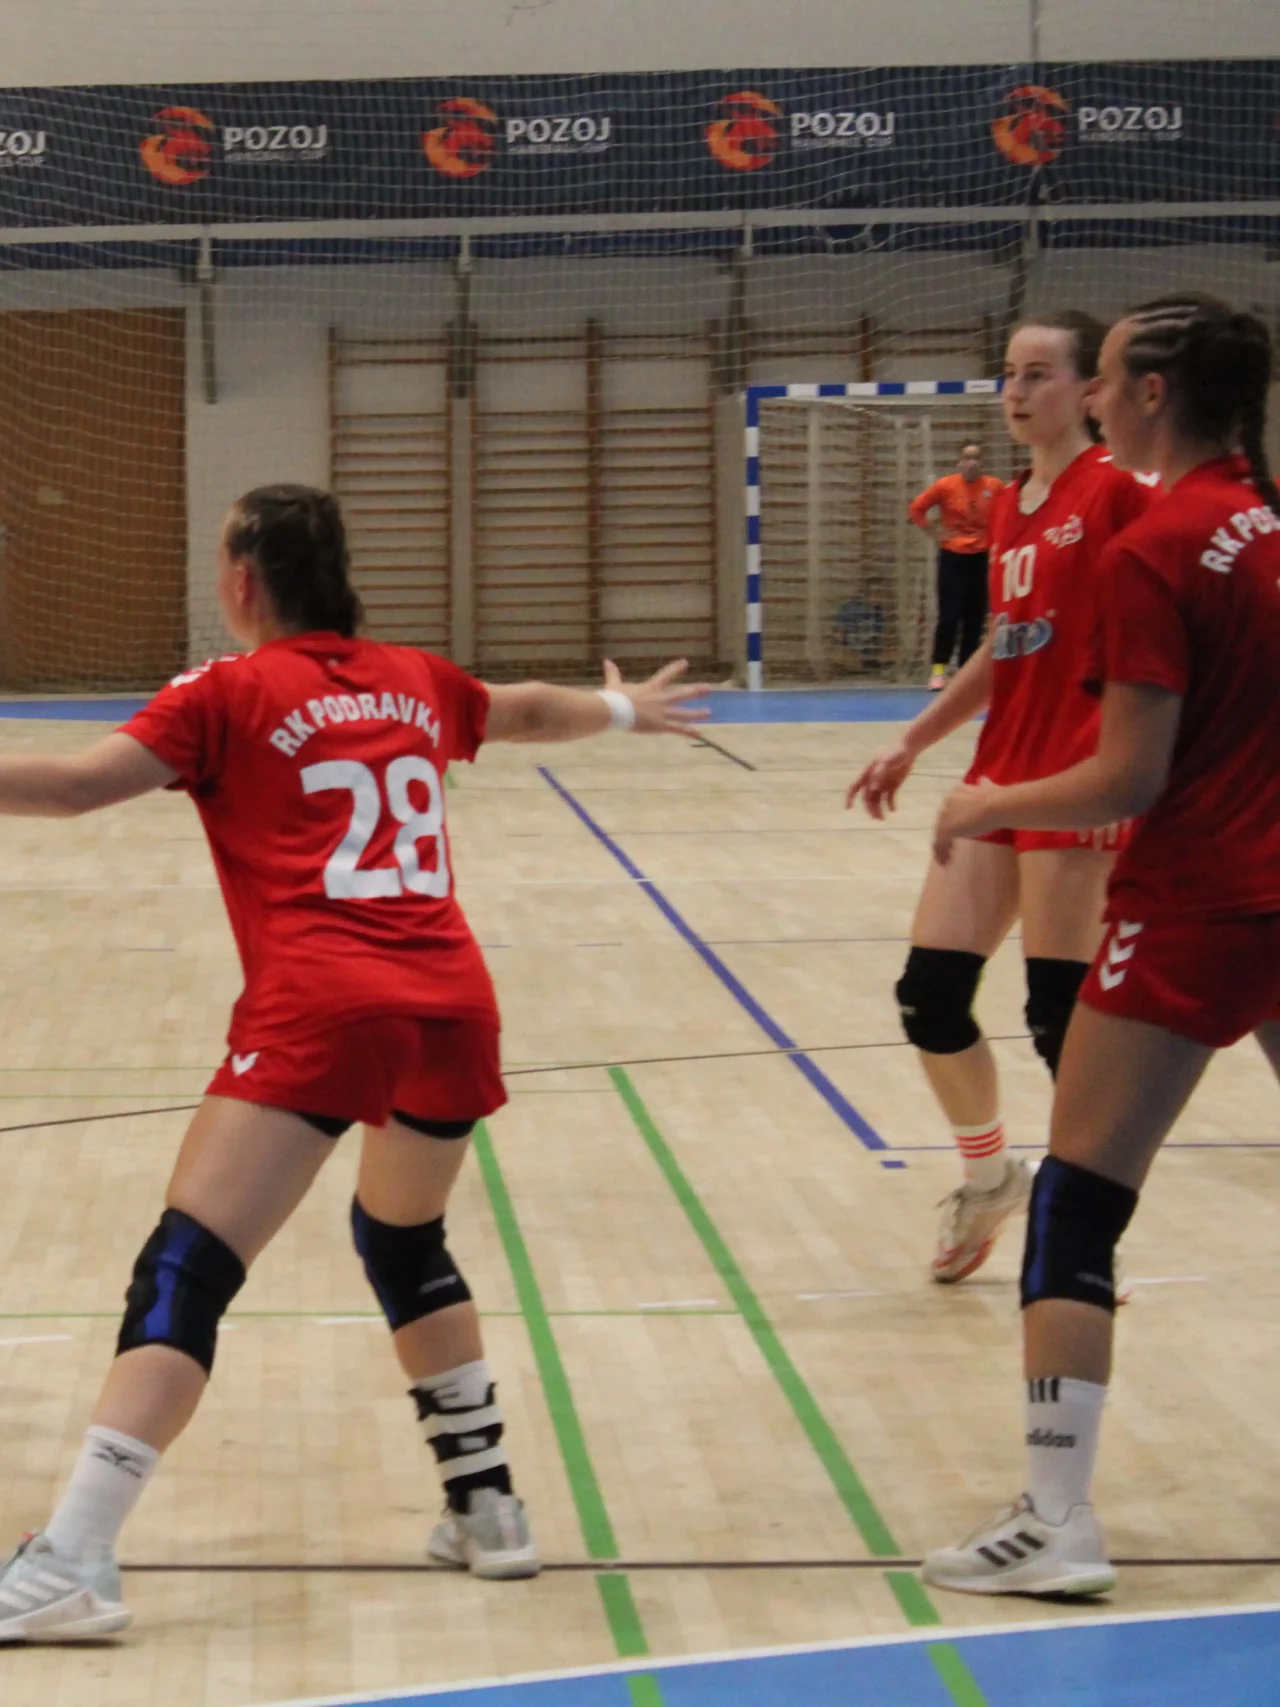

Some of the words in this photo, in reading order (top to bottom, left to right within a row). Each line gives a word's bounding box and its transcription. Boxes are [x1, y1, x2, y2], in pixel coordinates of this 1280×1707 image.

[506, 117, 611, 143] POZOJ
[791, 112, 895, 136] POZOJ
[1079, 106, 1183, 132] POZOJ
[224, 125, 327, 151] POZOJ
[1200, 527, 1246, 574] RK
[1000, 543, 1037, 602] 10
[269, 709, 315, 758] RK
[306, 692, 440, 748] PODRAVKA
[300, 755, 449, 900] 28
